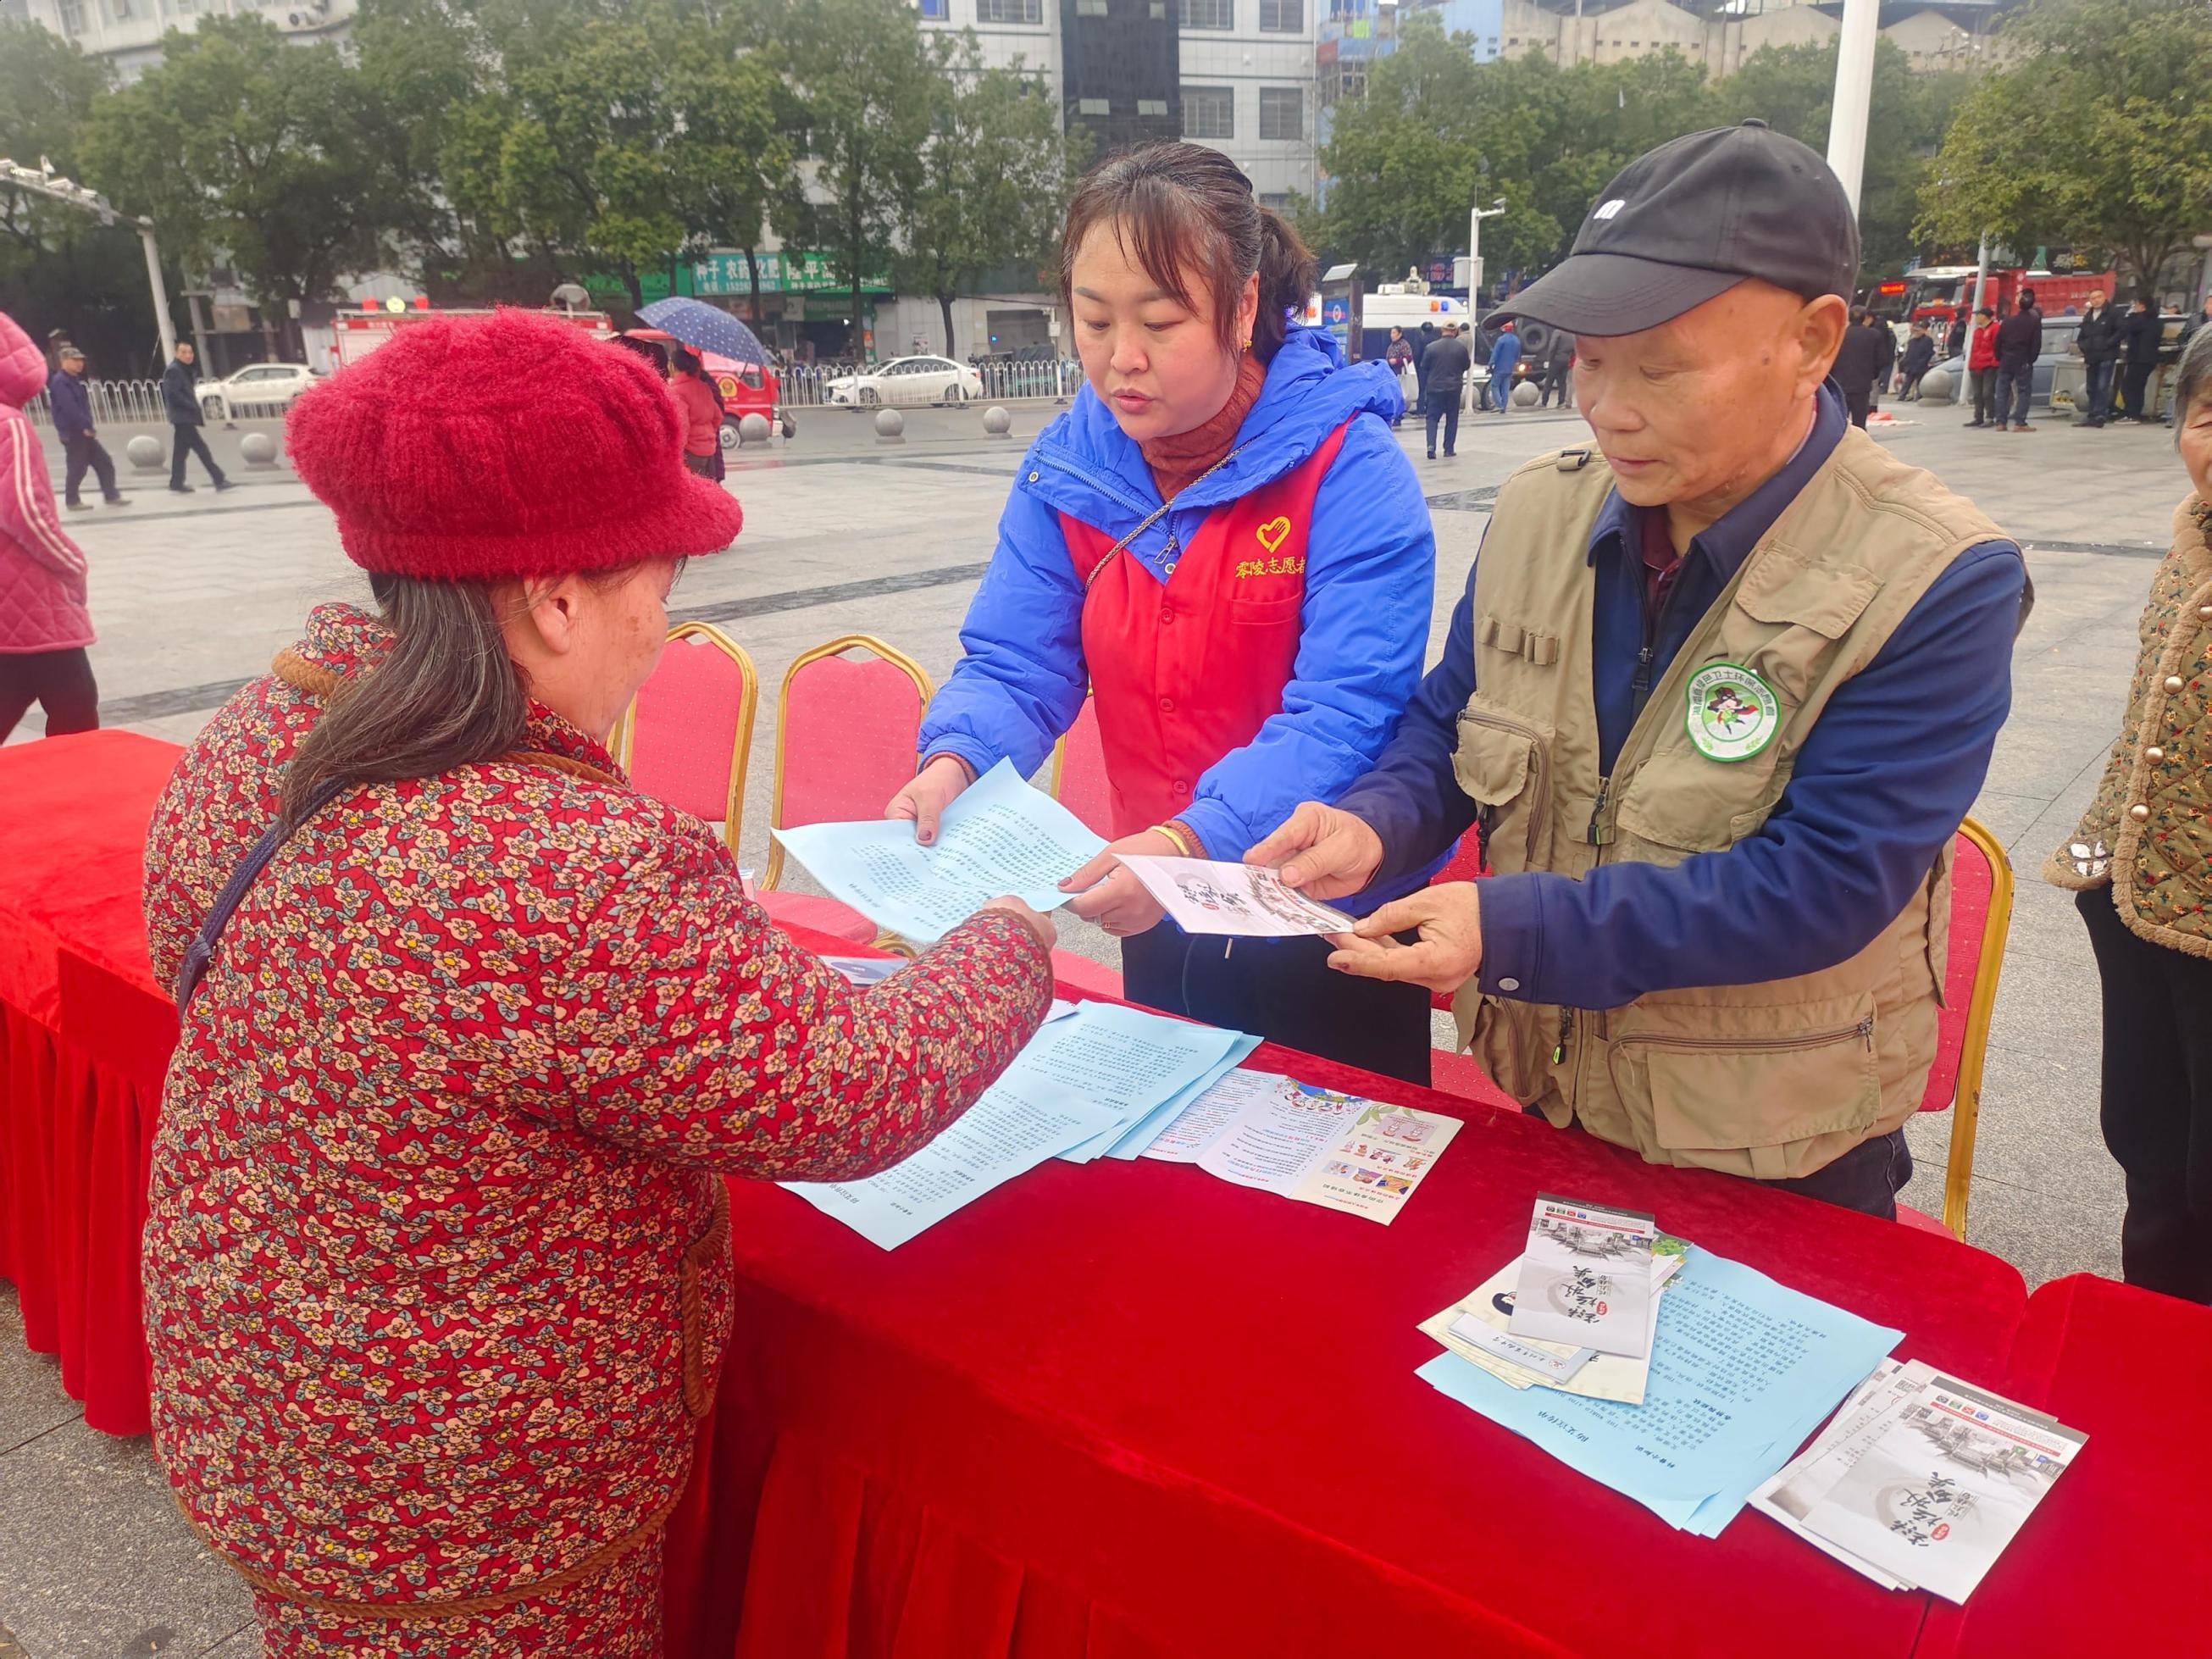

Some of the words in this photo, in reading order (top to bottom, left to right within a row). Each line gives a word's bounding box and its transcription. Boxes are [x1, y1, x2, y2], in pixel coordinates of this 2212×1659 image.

[696, 263, 719, 280] 种子
[726, 259, 751, 280] 农药
[757, 258, 779, 280] 化肥
[1235, 556, 1306, 579] 零陵志愿者
